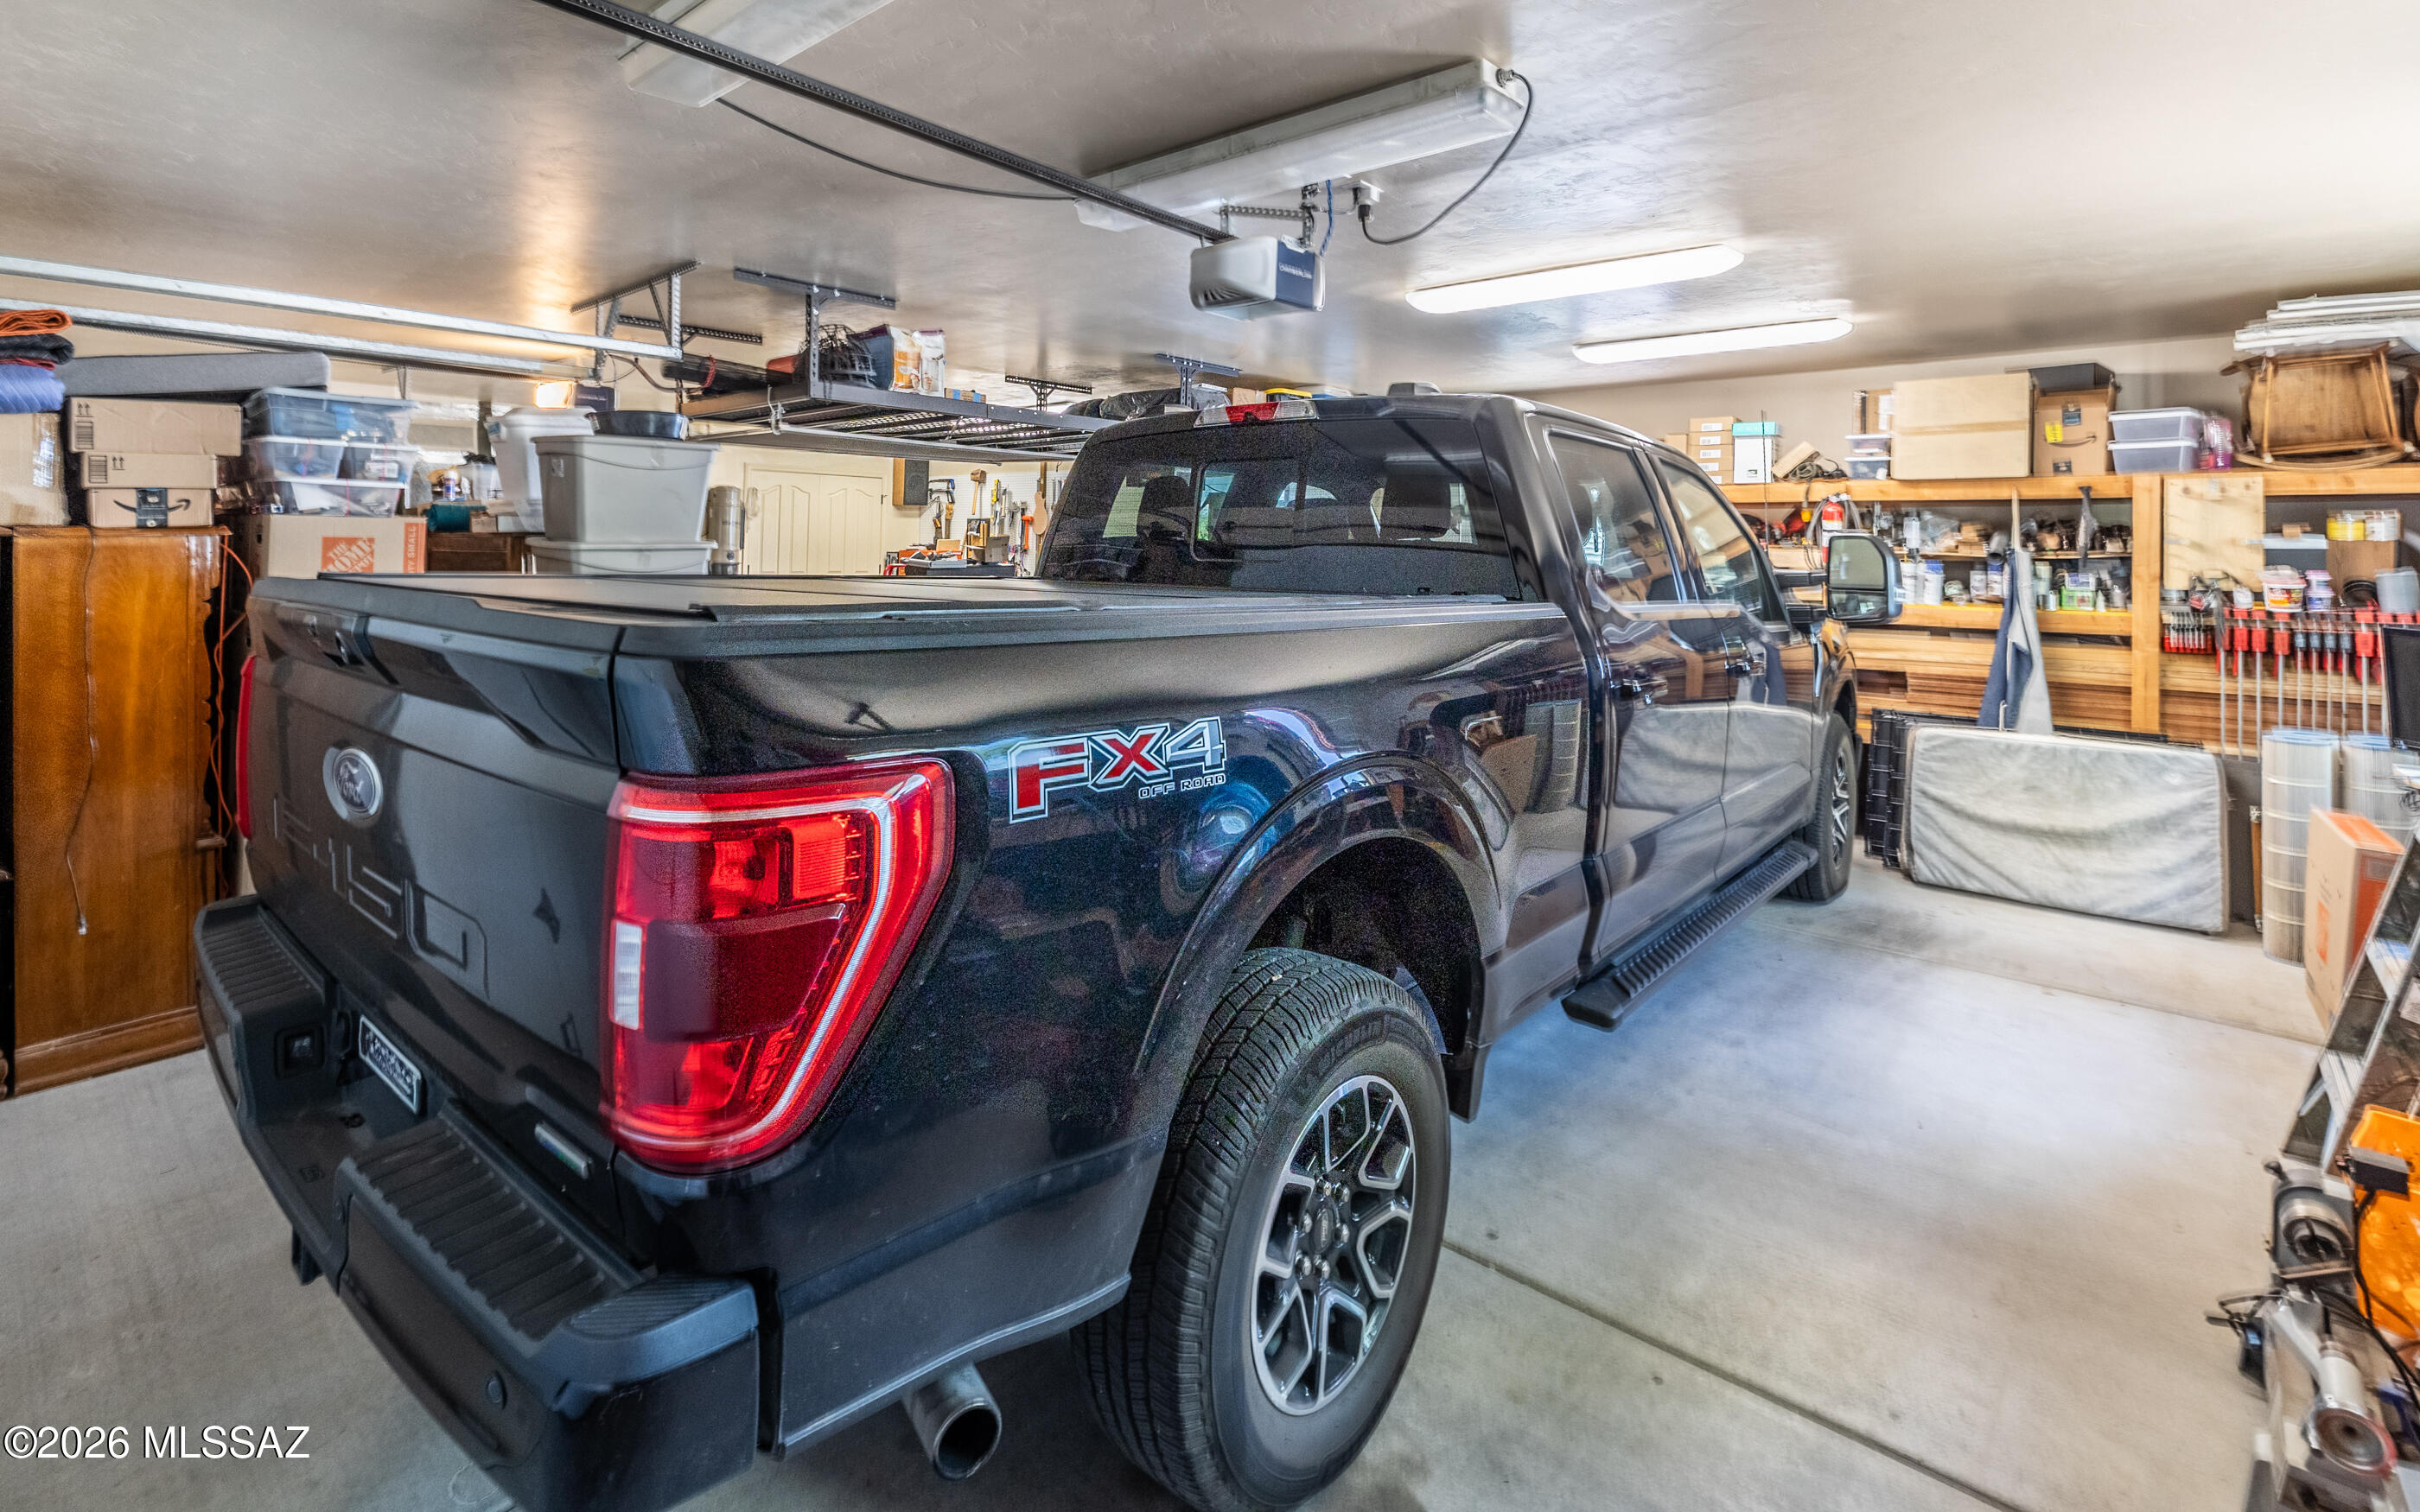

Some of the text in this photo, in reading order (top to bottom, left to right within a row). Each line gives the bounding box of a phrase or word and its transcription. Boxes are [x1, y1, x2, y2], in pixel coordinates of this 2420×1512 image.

[1008, 715, 1227, 824] FX4
[1138, 772, 1226, 800] OFF ROAD
